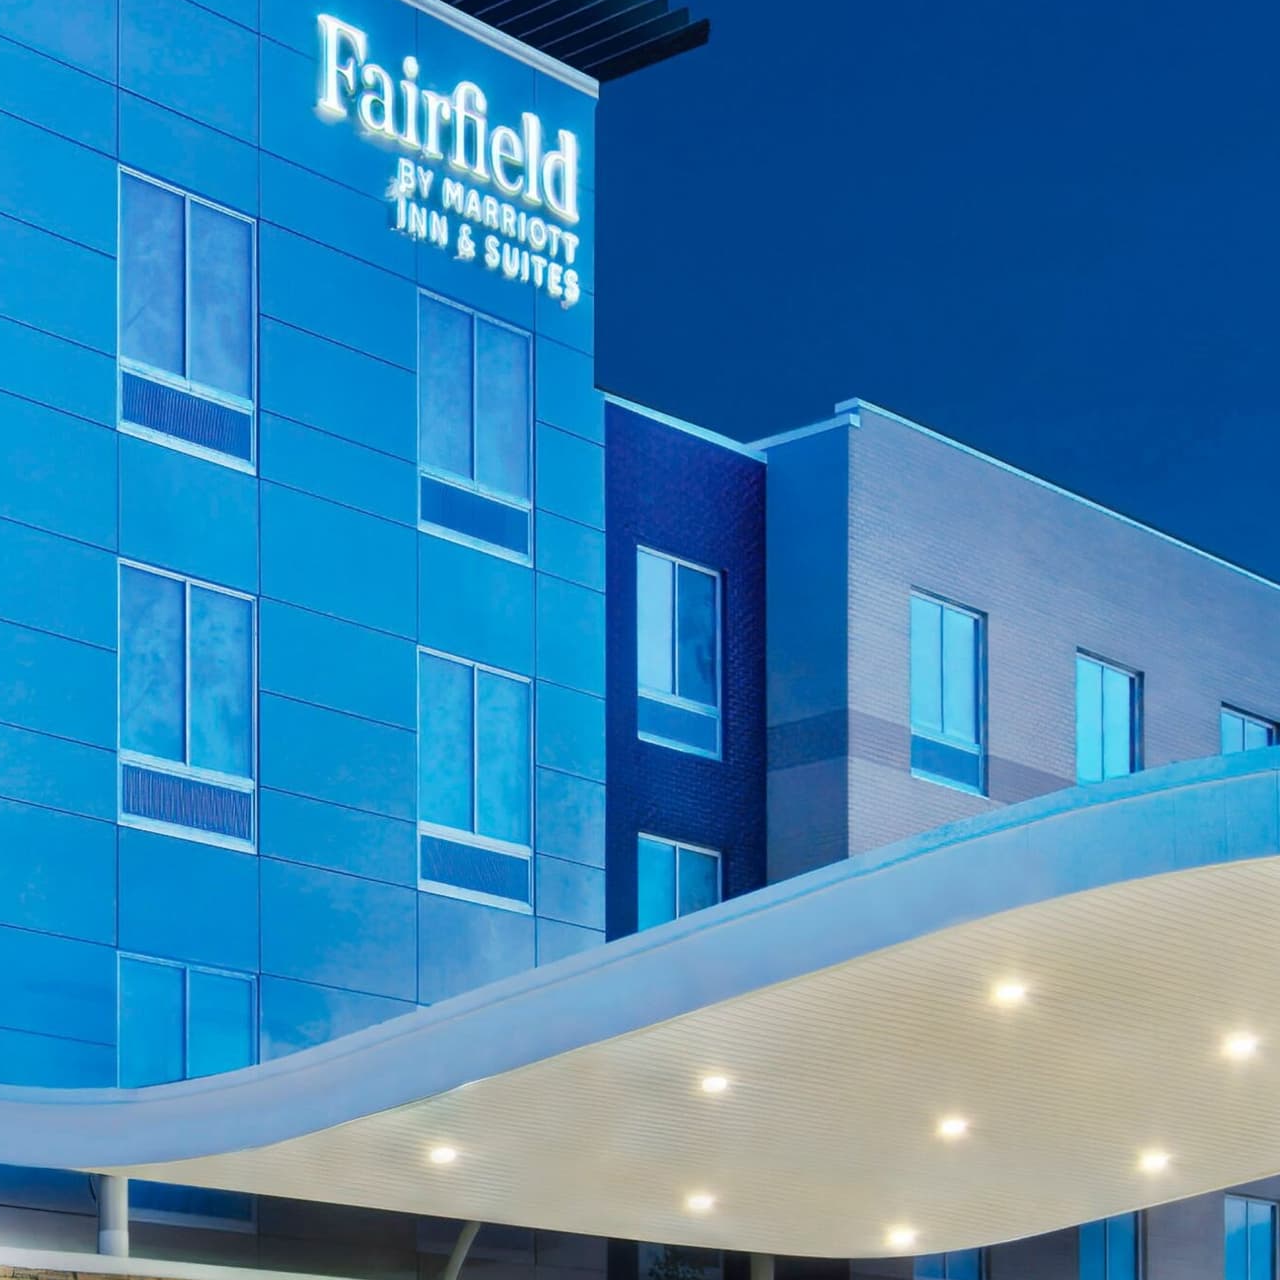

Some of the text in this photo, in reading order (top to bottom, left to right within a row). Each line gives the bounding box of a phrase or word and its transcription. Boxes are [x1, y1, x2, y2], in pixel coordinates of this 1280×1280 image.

[317, 13, 580, 222] Fairfield
[396, 194, 580, 305] INN & SUITES
[397, 158, 580, 264] BY MARRIOTT
